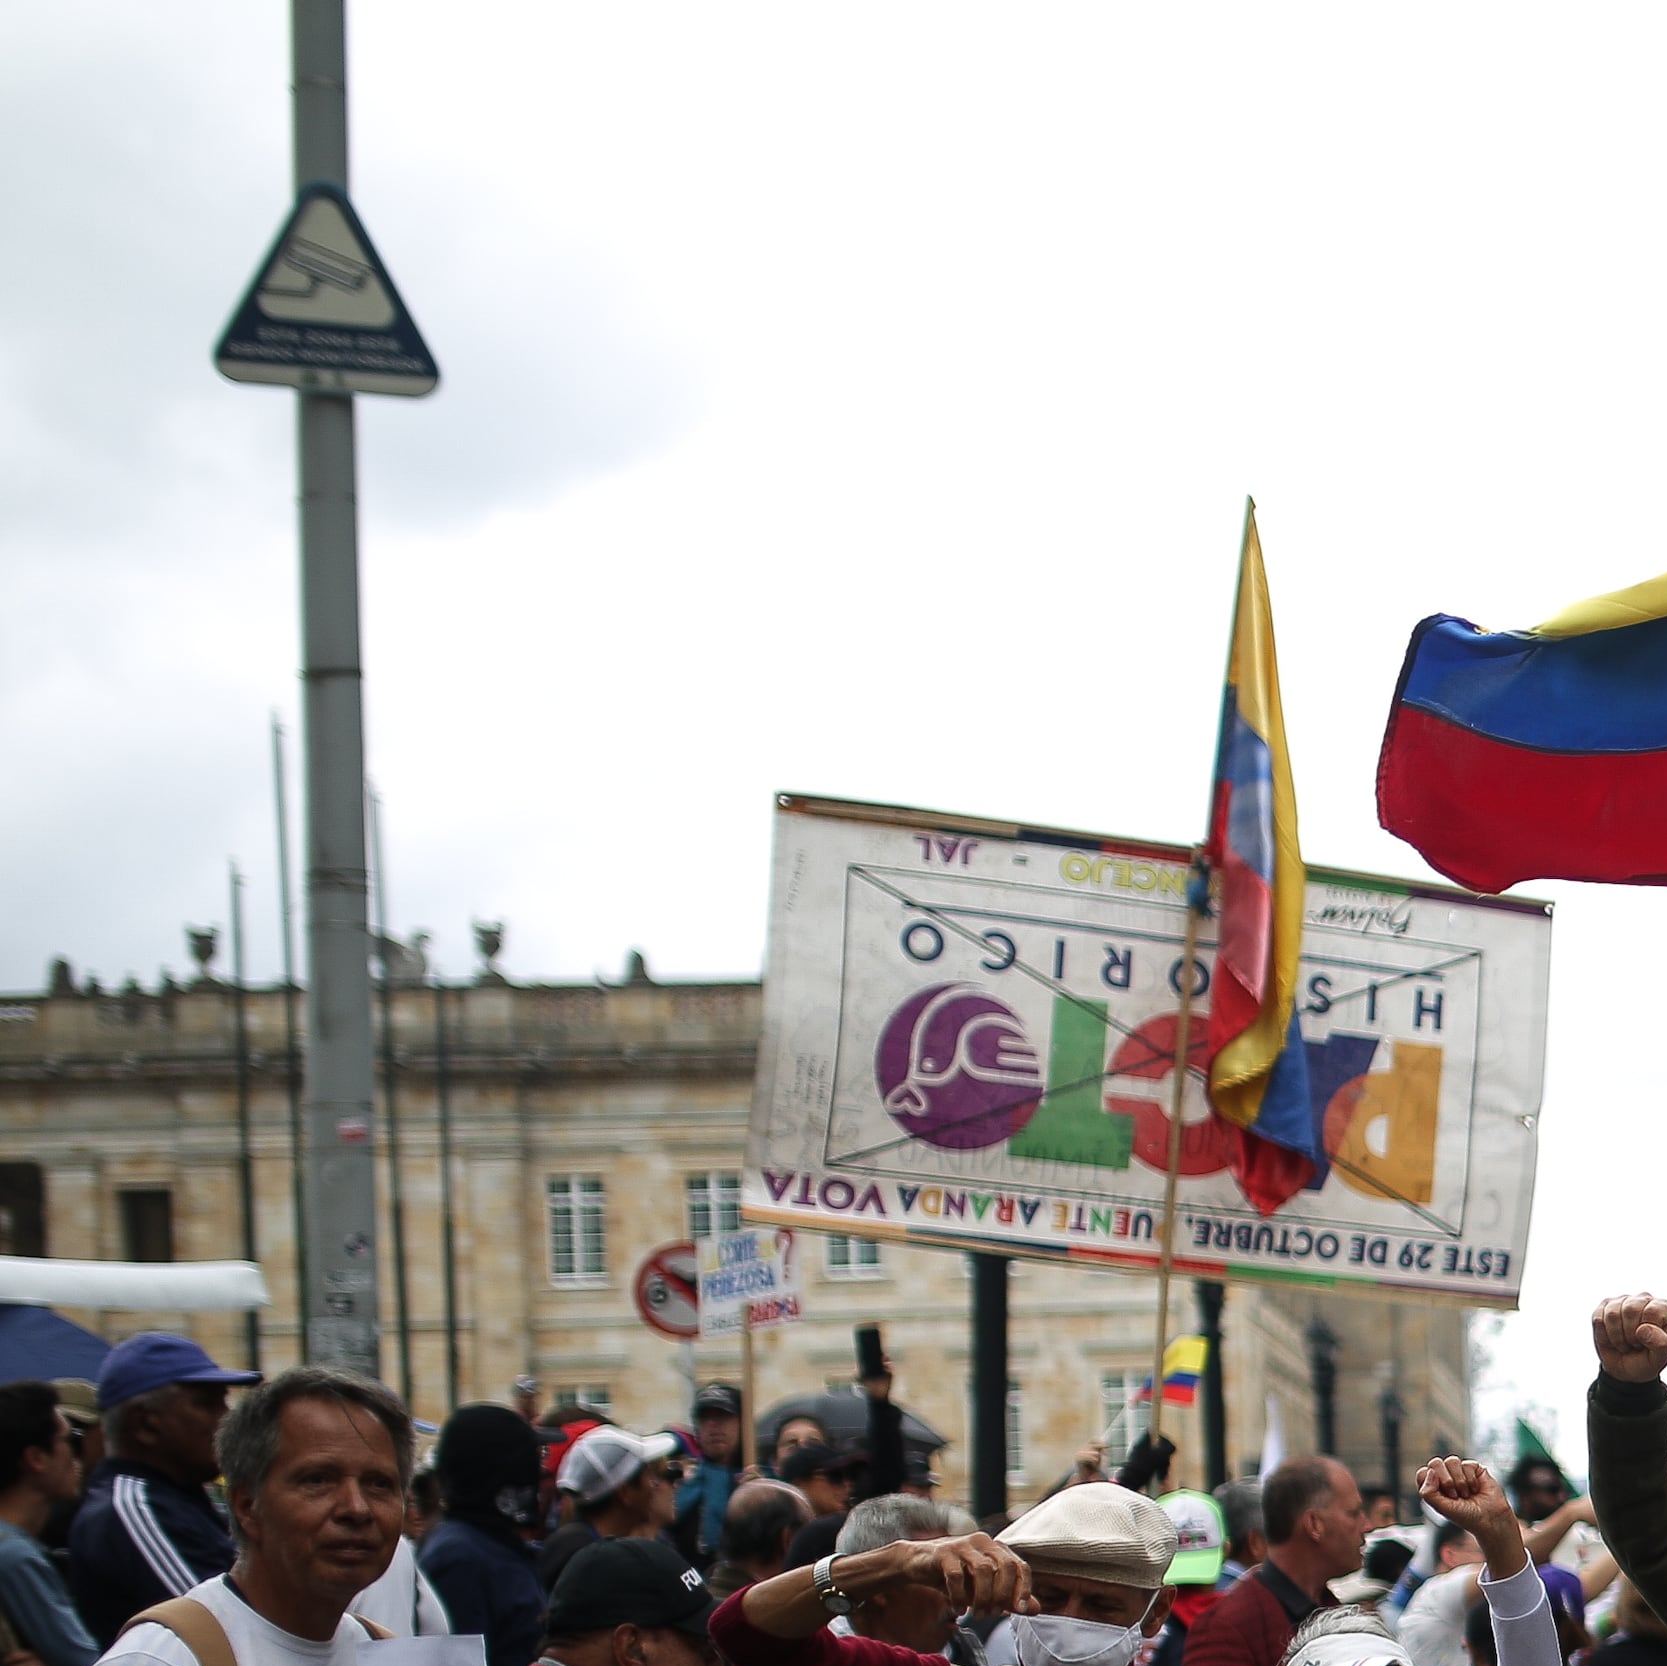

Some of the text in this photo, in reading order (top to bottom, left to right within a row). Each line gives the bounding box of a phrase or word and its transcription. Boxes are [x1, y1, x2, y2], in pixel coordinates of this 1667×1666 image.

[912, 831, 979, 870] JAL
[901, 920, 1443, 1031] HISORICO
[763, 1170, 886, 1218] VOTA
[896, 1184, 1040, 1227] ARANDA
[1052, 1201, 1168, 1245] UENTE
[1351, 1233, 1389, 1266] DE
[1399, 1238, 1434, 1271] 29
[1444, 1245, 1510, 1277] ESTE
